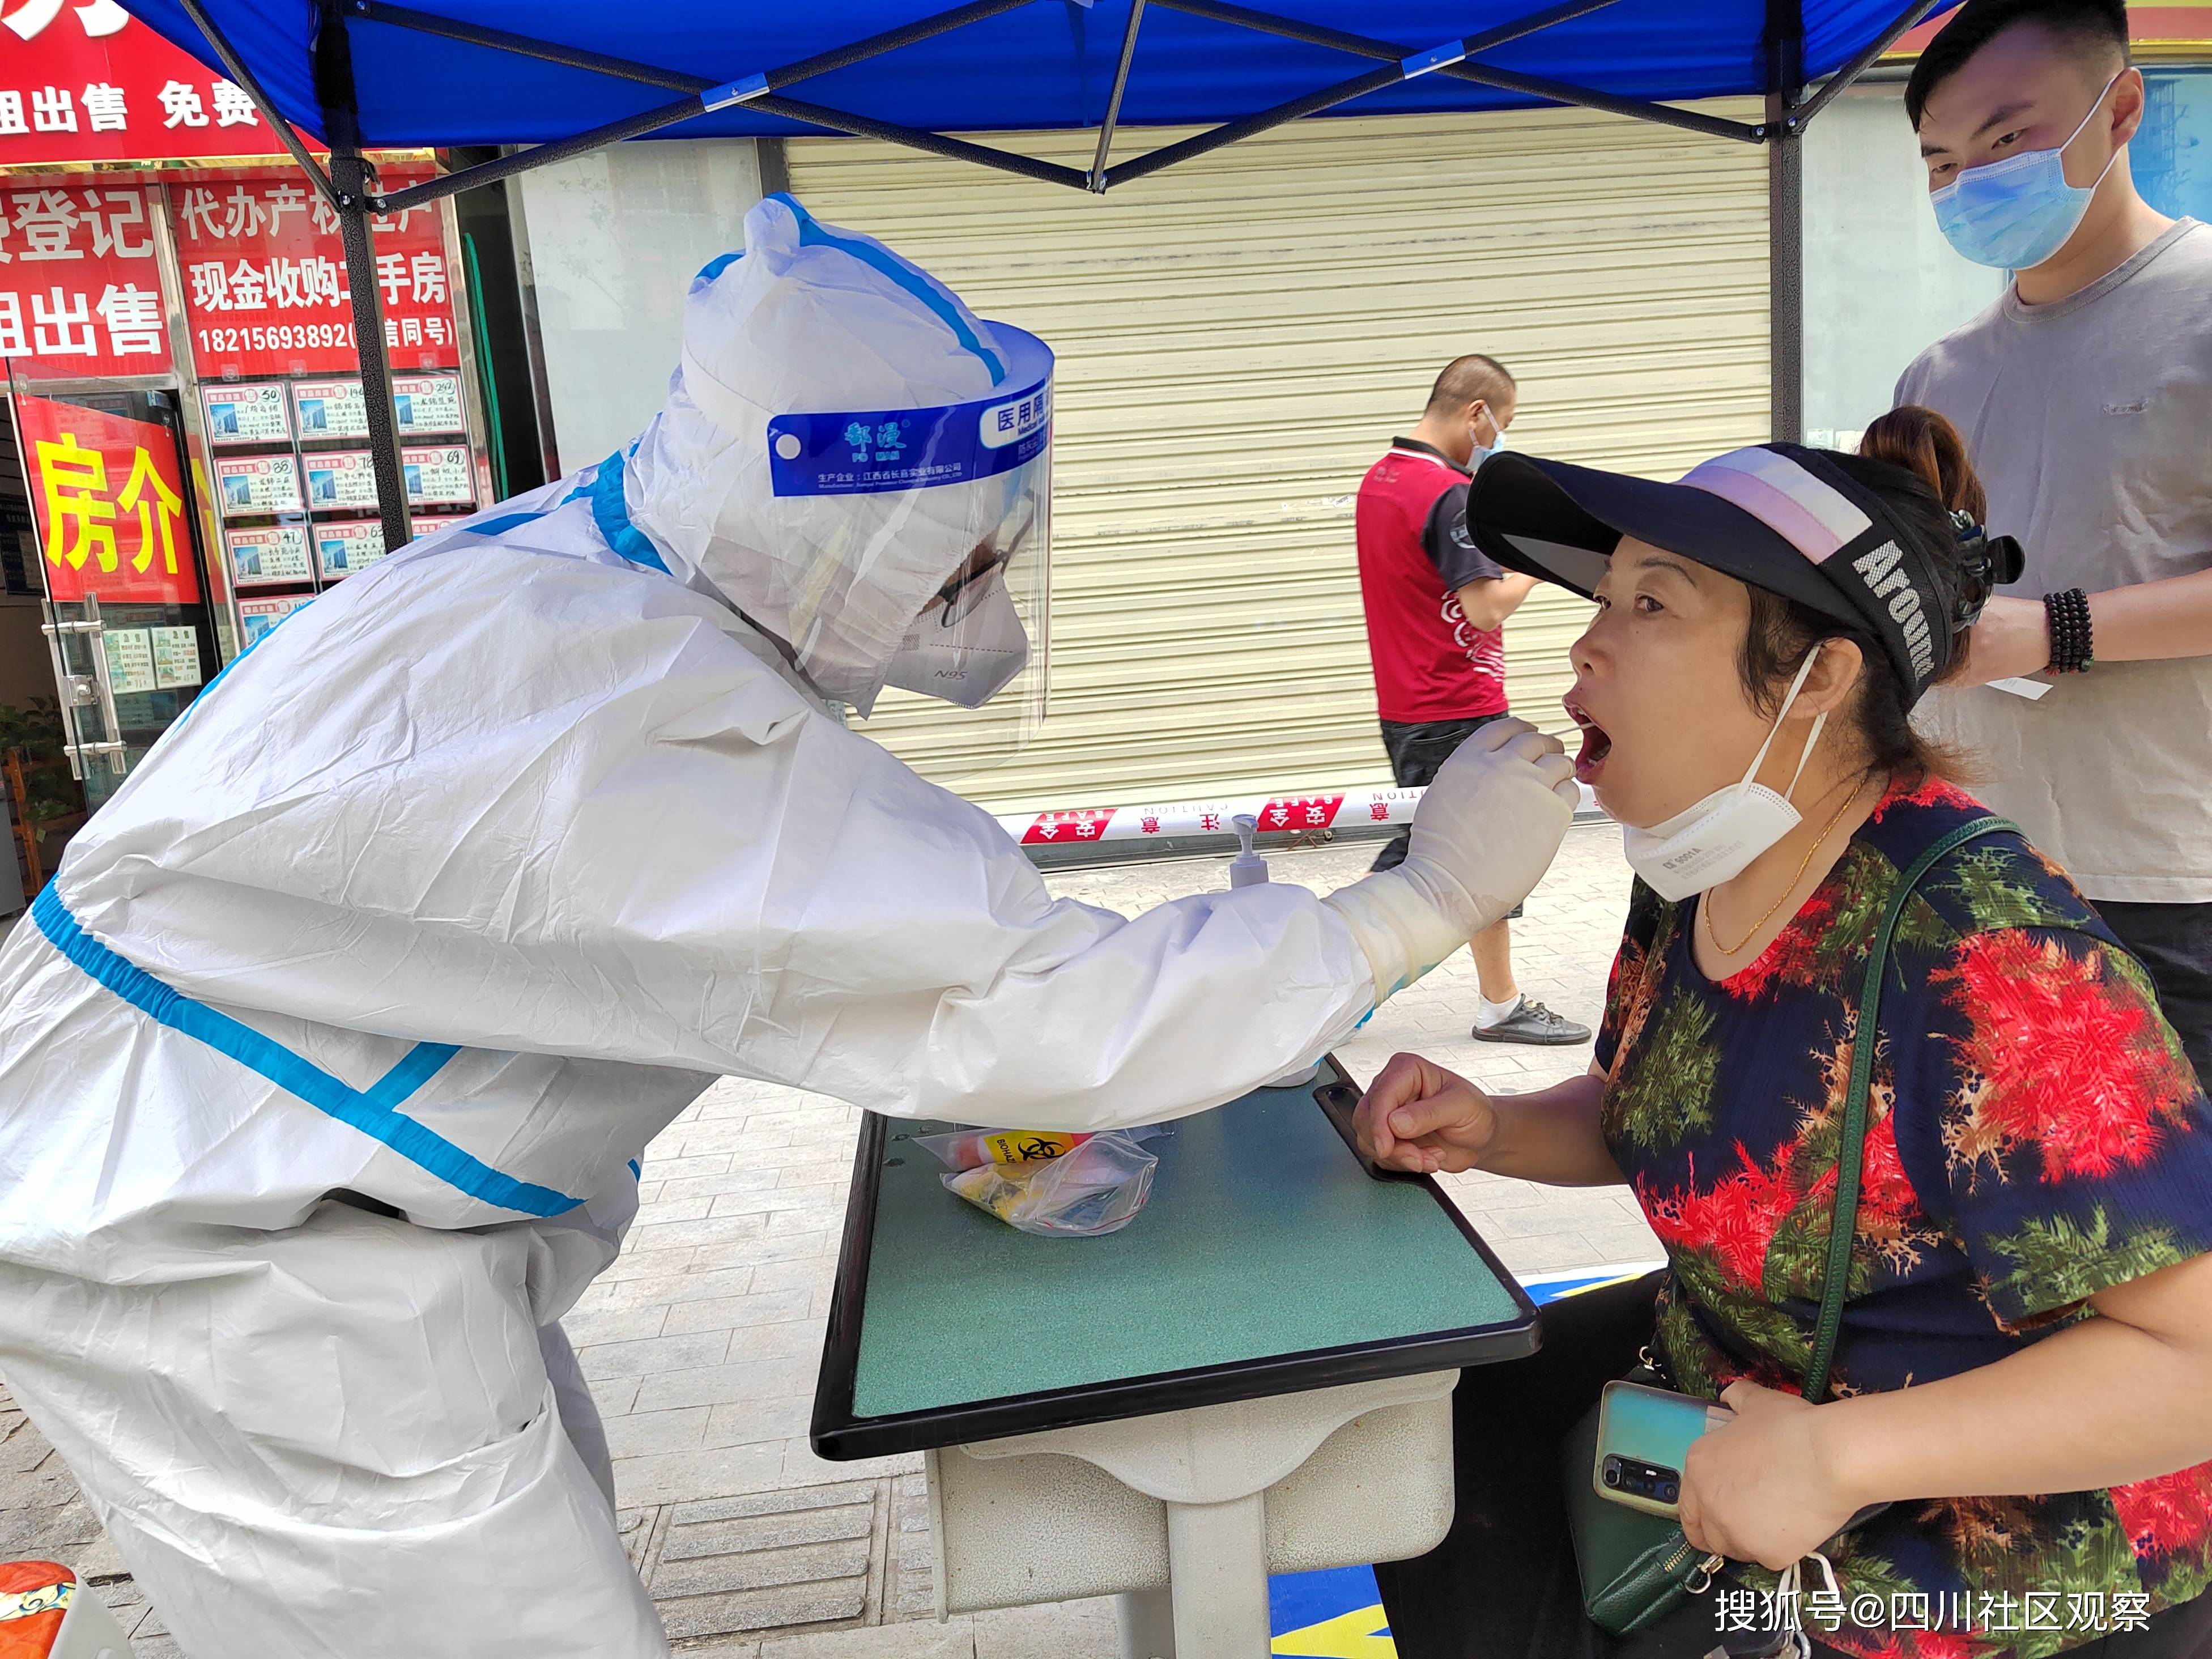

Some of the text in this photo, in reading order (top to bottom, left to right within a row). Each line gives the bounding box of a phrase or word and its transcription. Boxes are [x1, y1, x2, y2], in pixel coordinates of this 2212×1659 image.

[157, 78, 259, 129] 免费
[0, 189, 154, 263] 登记
[199, 318, 453, 352] 18215693892(信同号)
[447, 450, 460, 464] 69
[35, 432, 182, 574] 房介
[934, 670, 968, 680] N95
[1274, 794, 1333, 807] SAFE
[1045, 810, 1104, 822] SAFE
[1269, 806, 1325, 827] 安全
[1039, 819, 1095, 840] 安全
[997, 1139, 1016, 1163] BIOHAZ
